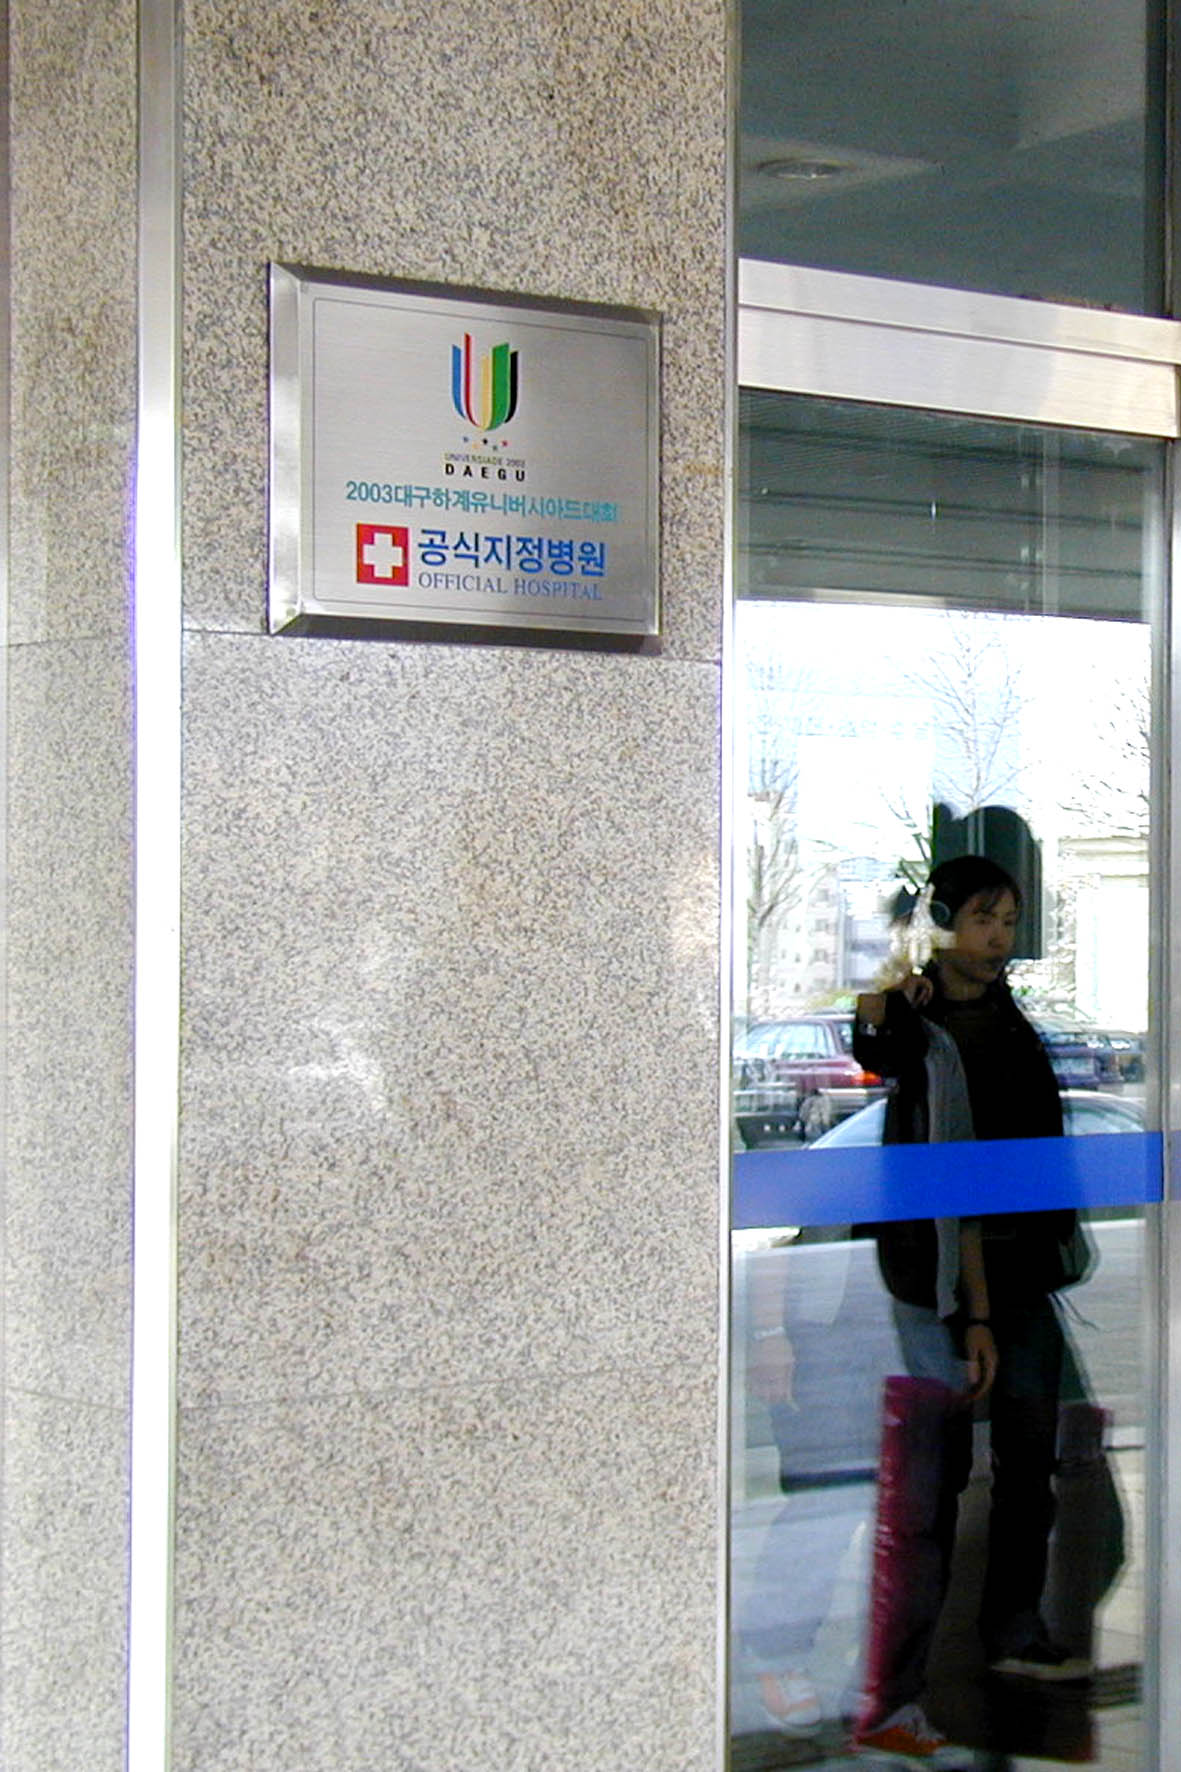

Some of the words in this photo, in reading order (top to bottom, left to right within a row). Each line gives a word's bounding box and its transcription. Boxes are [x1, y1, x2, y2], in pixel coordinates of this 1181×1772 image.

[444, 463, 526, 482] DAEGU
[416, 528, 606, 577] 공식지정병원
[418, 571, 508, 595] OFFICIAL
[514, 577, 603, 601] HOSPITAL
